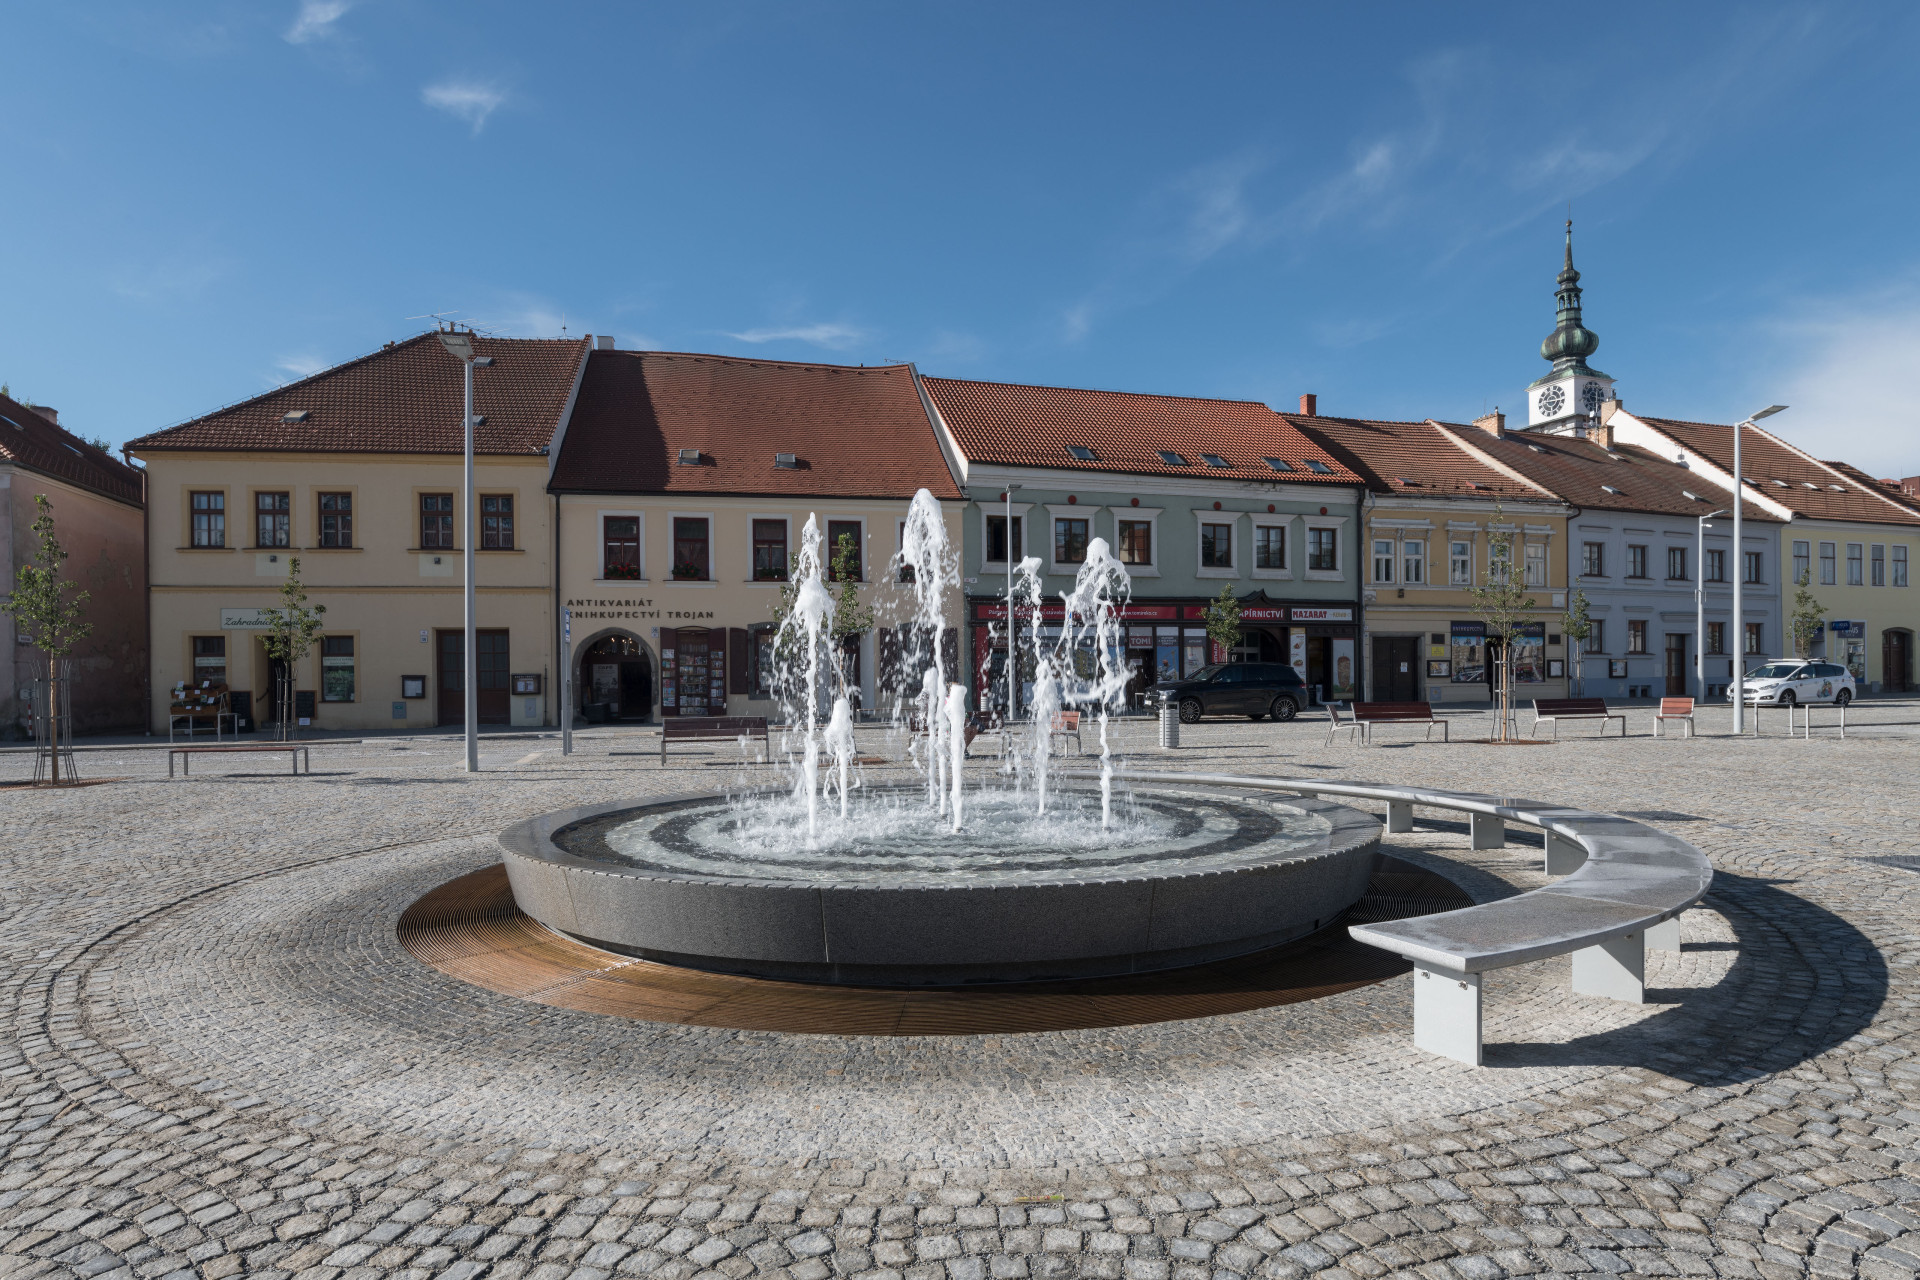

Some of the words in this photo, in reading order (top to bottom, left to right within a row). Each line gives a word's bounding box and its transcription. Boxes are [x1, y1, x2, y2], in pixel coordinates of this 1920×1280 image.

[567, 598, 653, 607] ANTIKVARIÁT
[569, 609, 660, 619] KNIHKUPECTVÍ
[667, 611, 714, 619] TROJAN
[1238, 608, 1284, 618] APÍRNICTVÍ
[1292, 610, 1328, 619] MAZARAT
[224, 617, 274, 626] Zahradnic
[1130, 637, 1151, 645] TOMI
